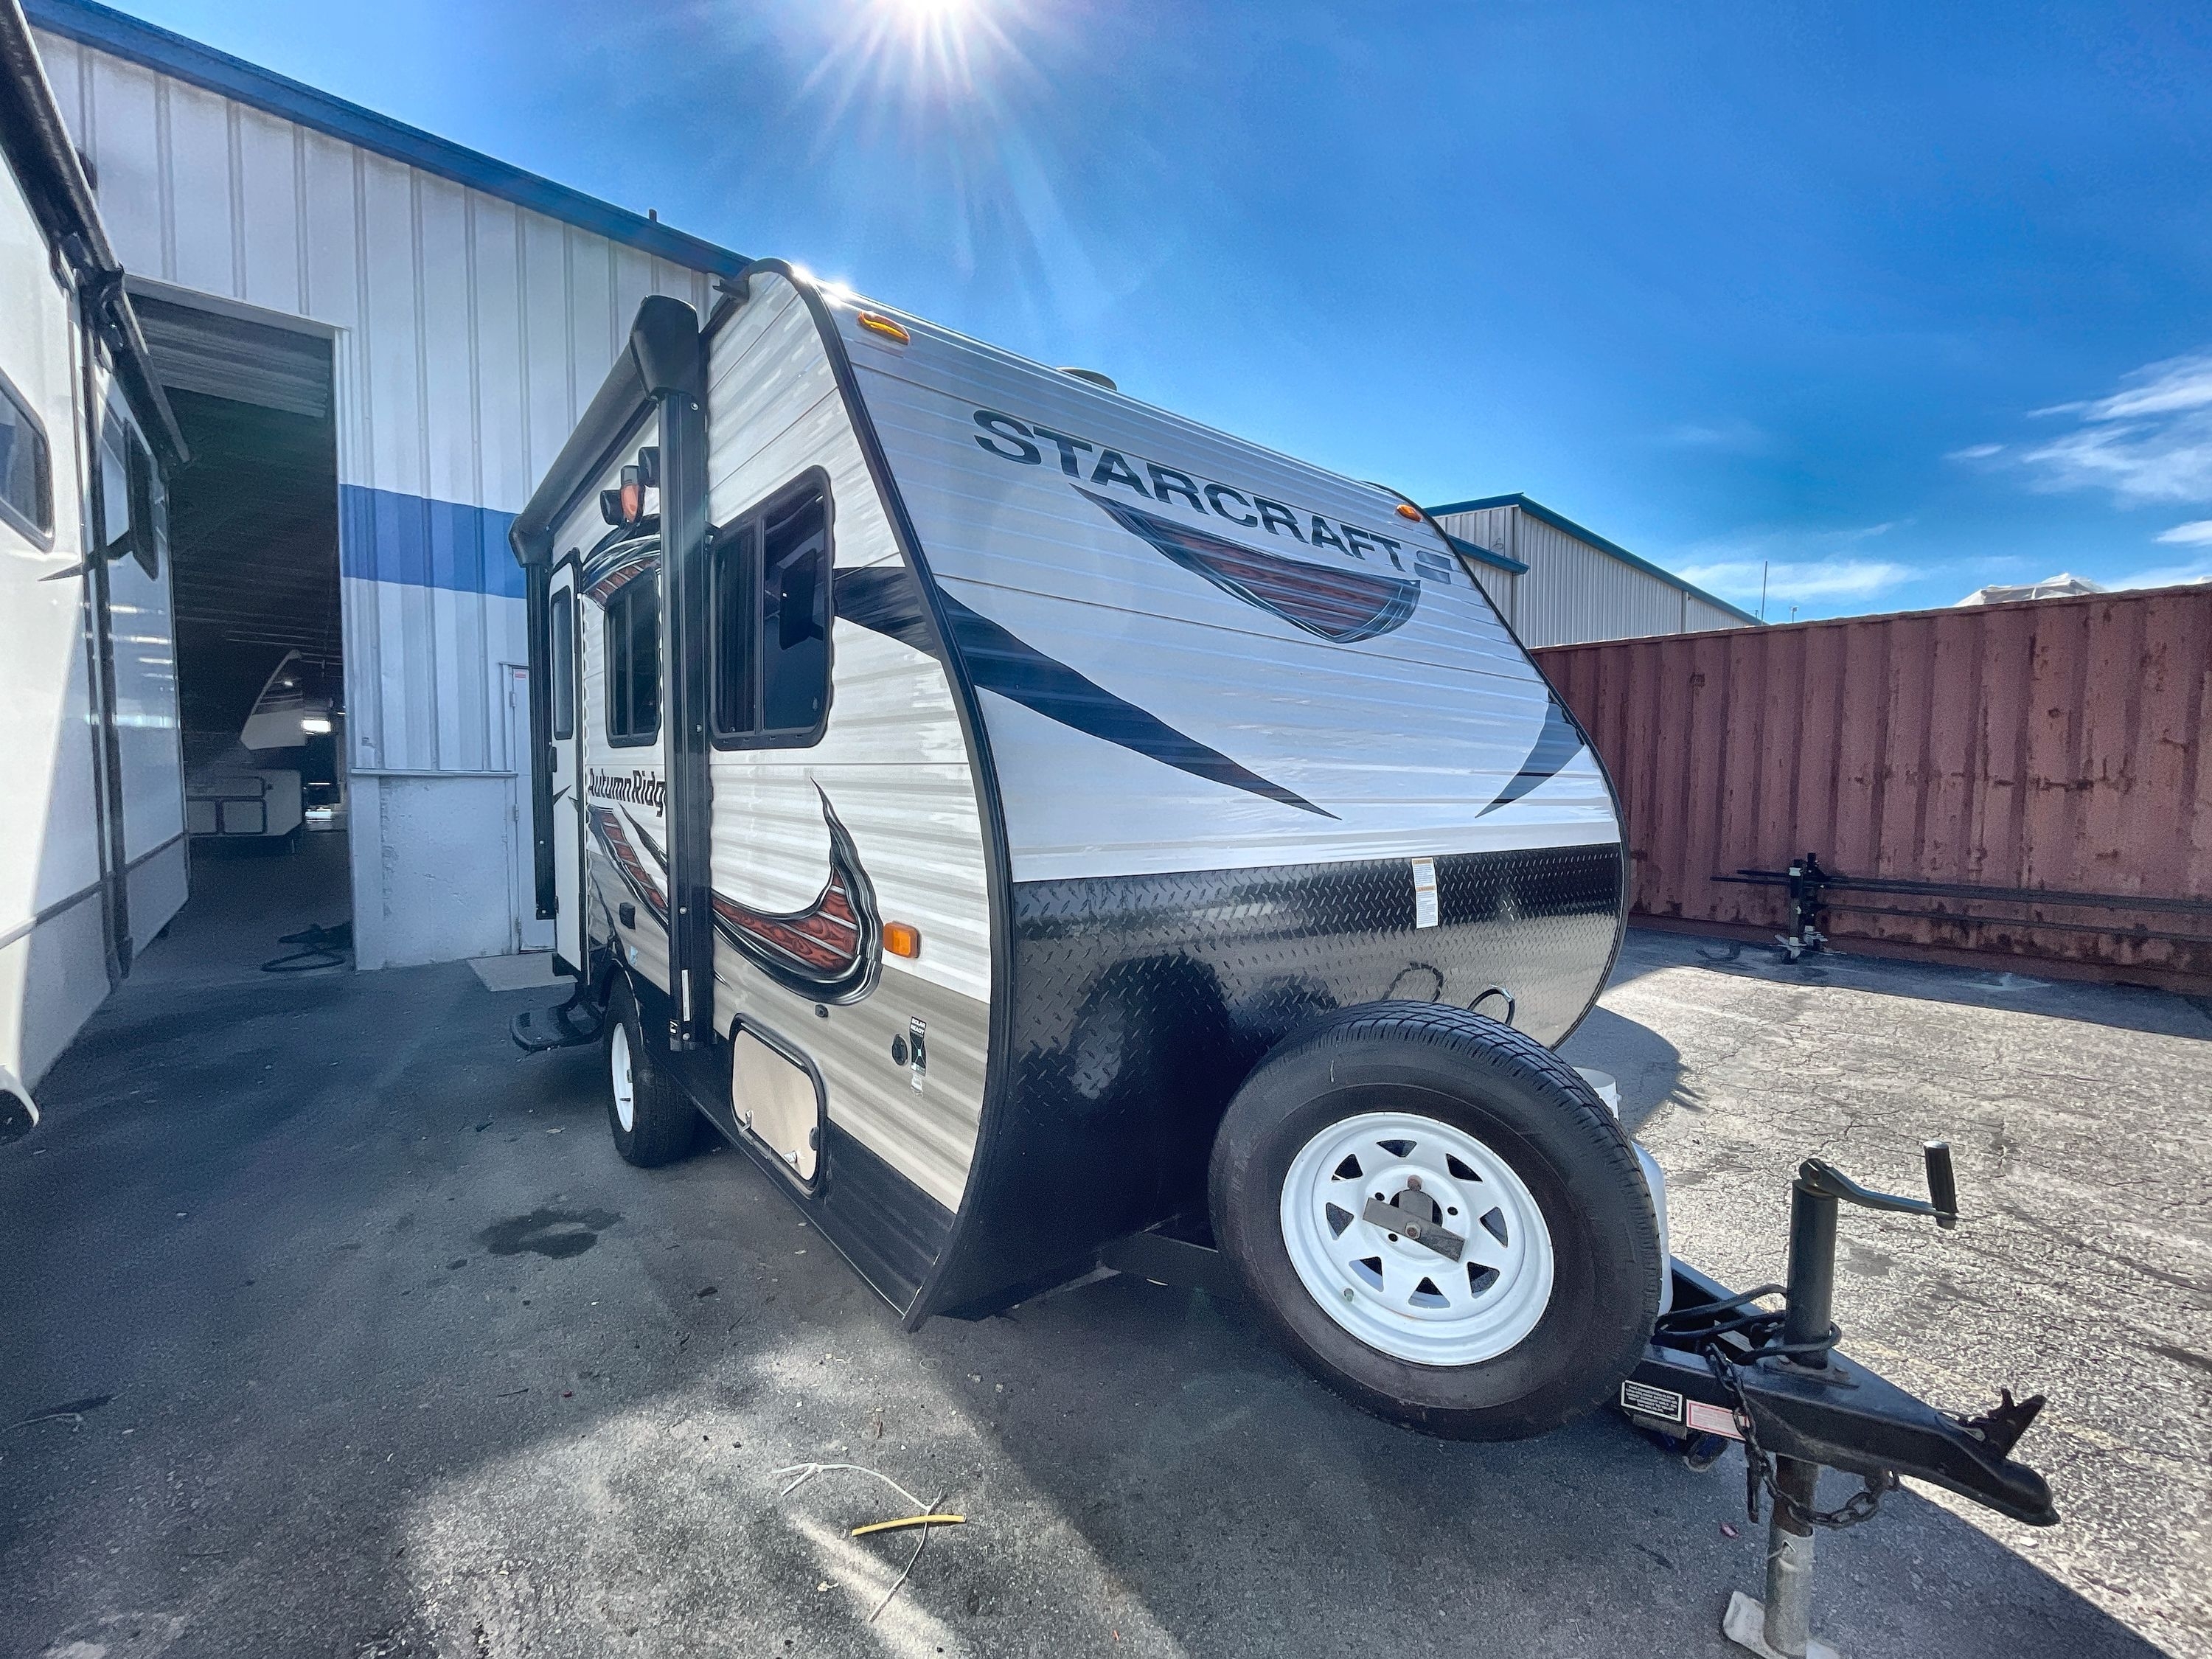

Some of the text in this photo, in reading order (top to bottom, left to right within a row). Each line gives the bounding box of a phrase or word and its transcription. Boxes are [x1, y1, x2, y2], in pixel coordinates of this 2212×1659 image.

[973, 409, 1406, 571] STARCRAFT
[910, 1024, 925, 1034] READY
[911, 1018, 925, 1029] SOLAR
